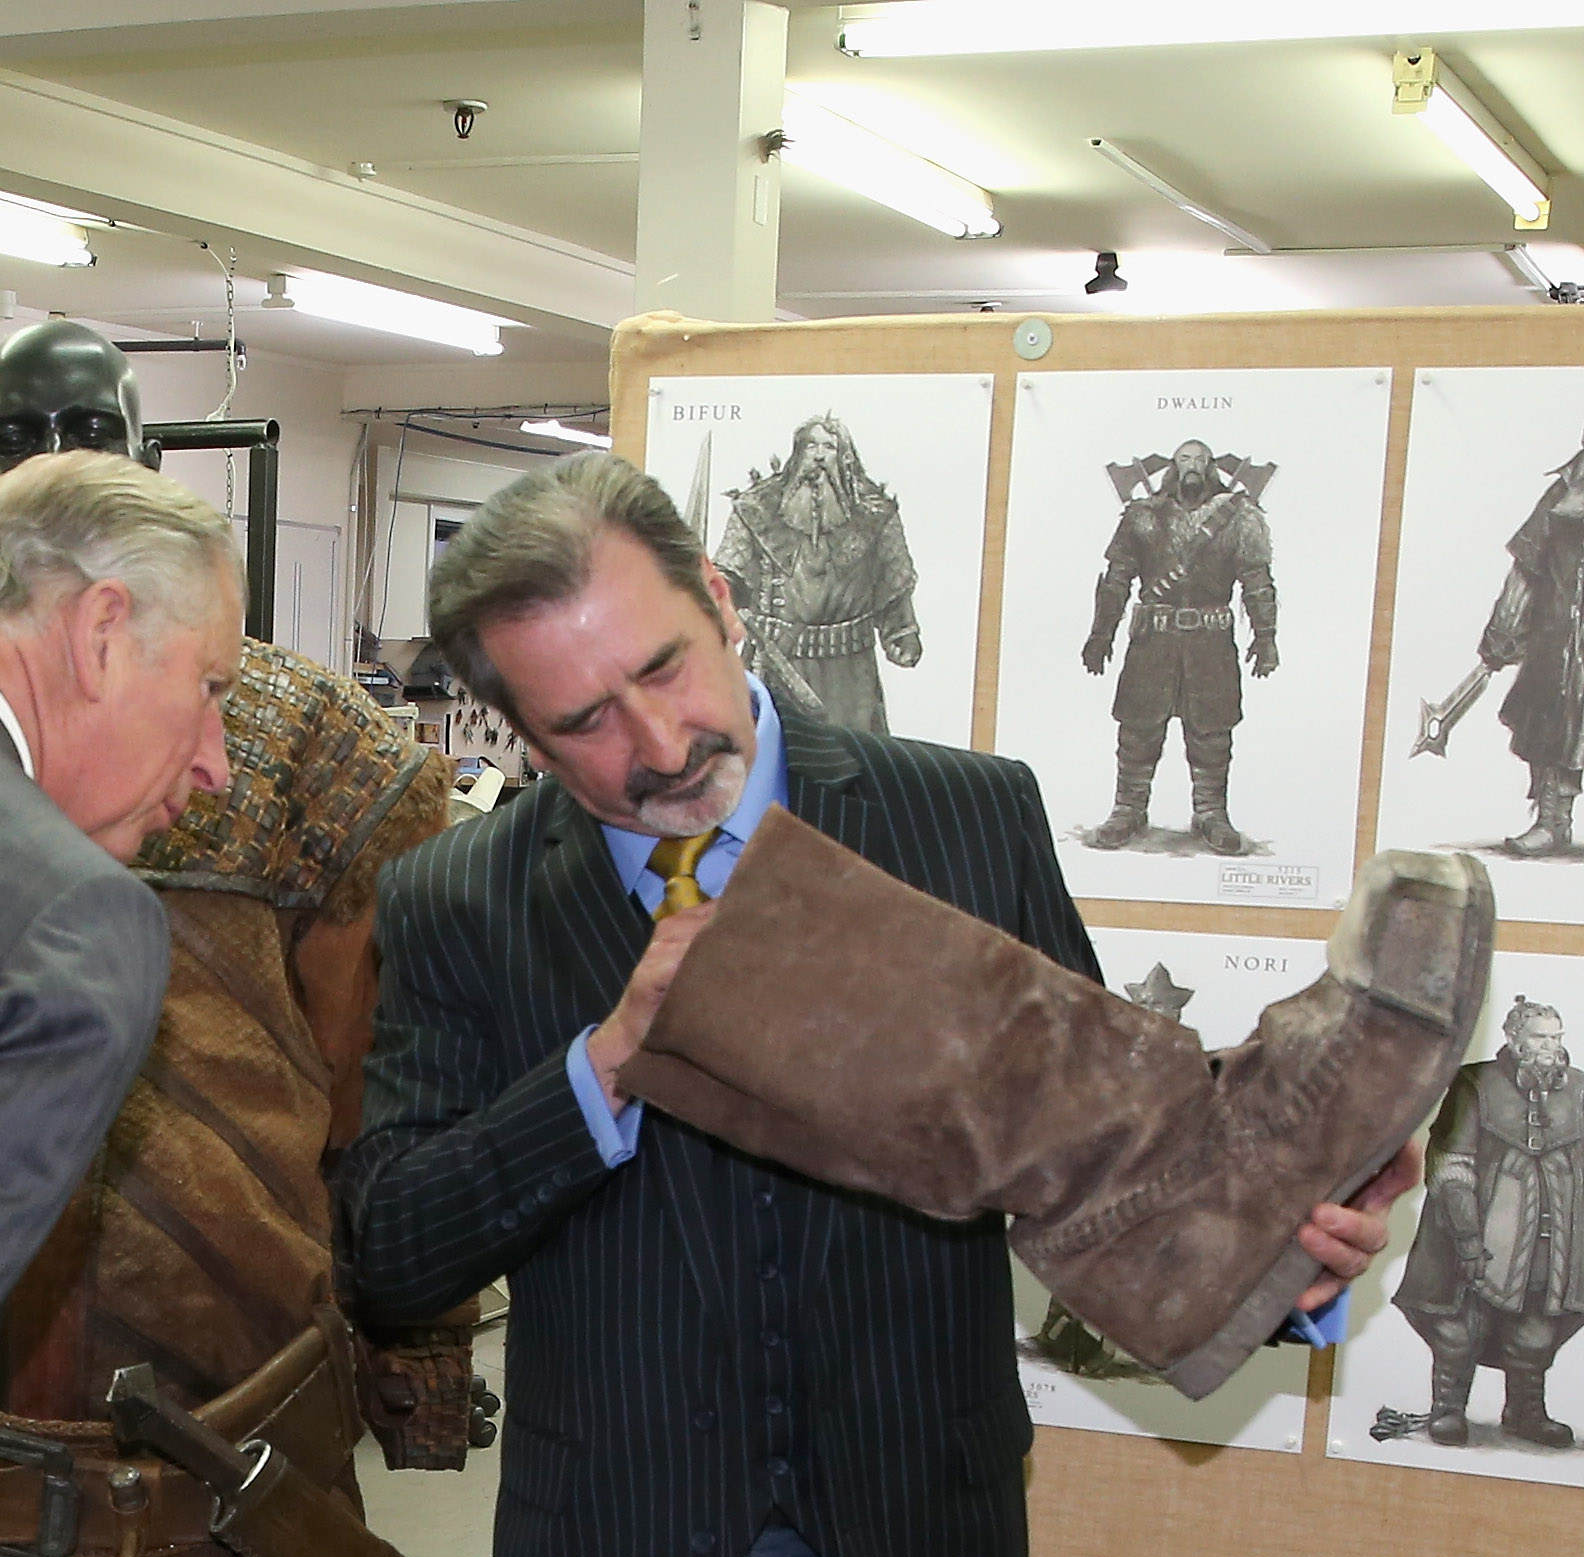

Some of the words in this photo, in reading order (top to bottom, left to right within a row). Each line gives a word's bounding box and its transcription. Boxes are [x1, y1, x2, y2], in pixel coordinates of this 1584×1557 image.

[1157, 397, 1232, 409] DWALIN
[673, 405, 742, 420] BIFUR
[1222, 873, 1263, 884] LITTLE
[1267, 875, 1311, 886] RIVERS
[1224, 955, 1287, 972] NORI
